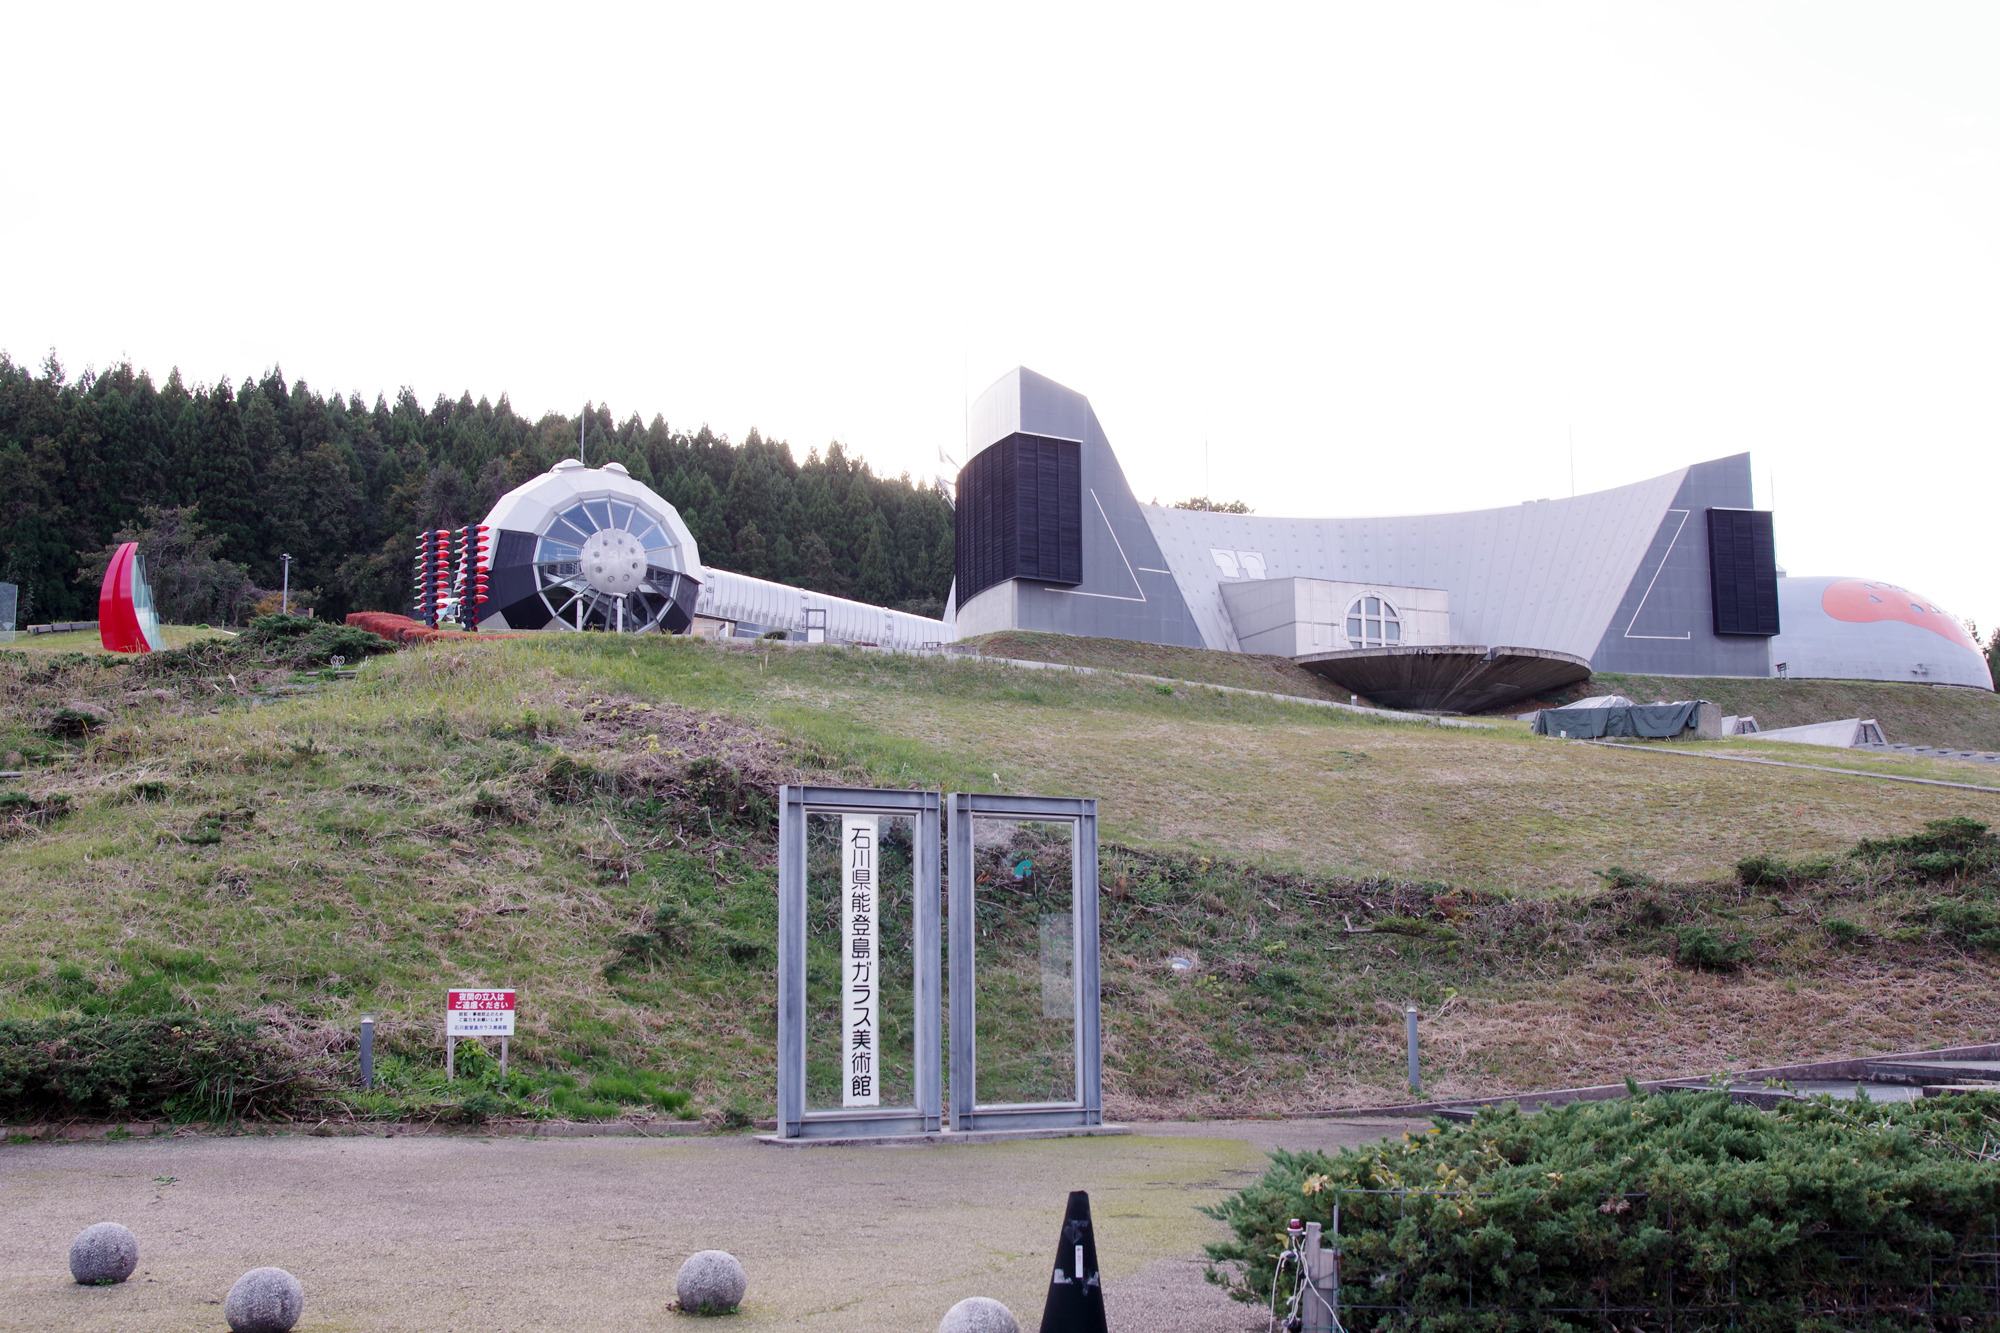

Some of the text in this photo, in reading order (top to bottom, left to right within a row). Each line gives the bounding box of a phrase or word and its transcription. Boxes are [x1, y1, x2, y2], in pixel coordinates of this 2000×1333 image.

[851, 827, 872, 1097] 石川県能登島ガラス美術館
[458, 993, 505, 1001] 夜間の立入は
[455, 1001, 509, 1010] ご遠慮ください
